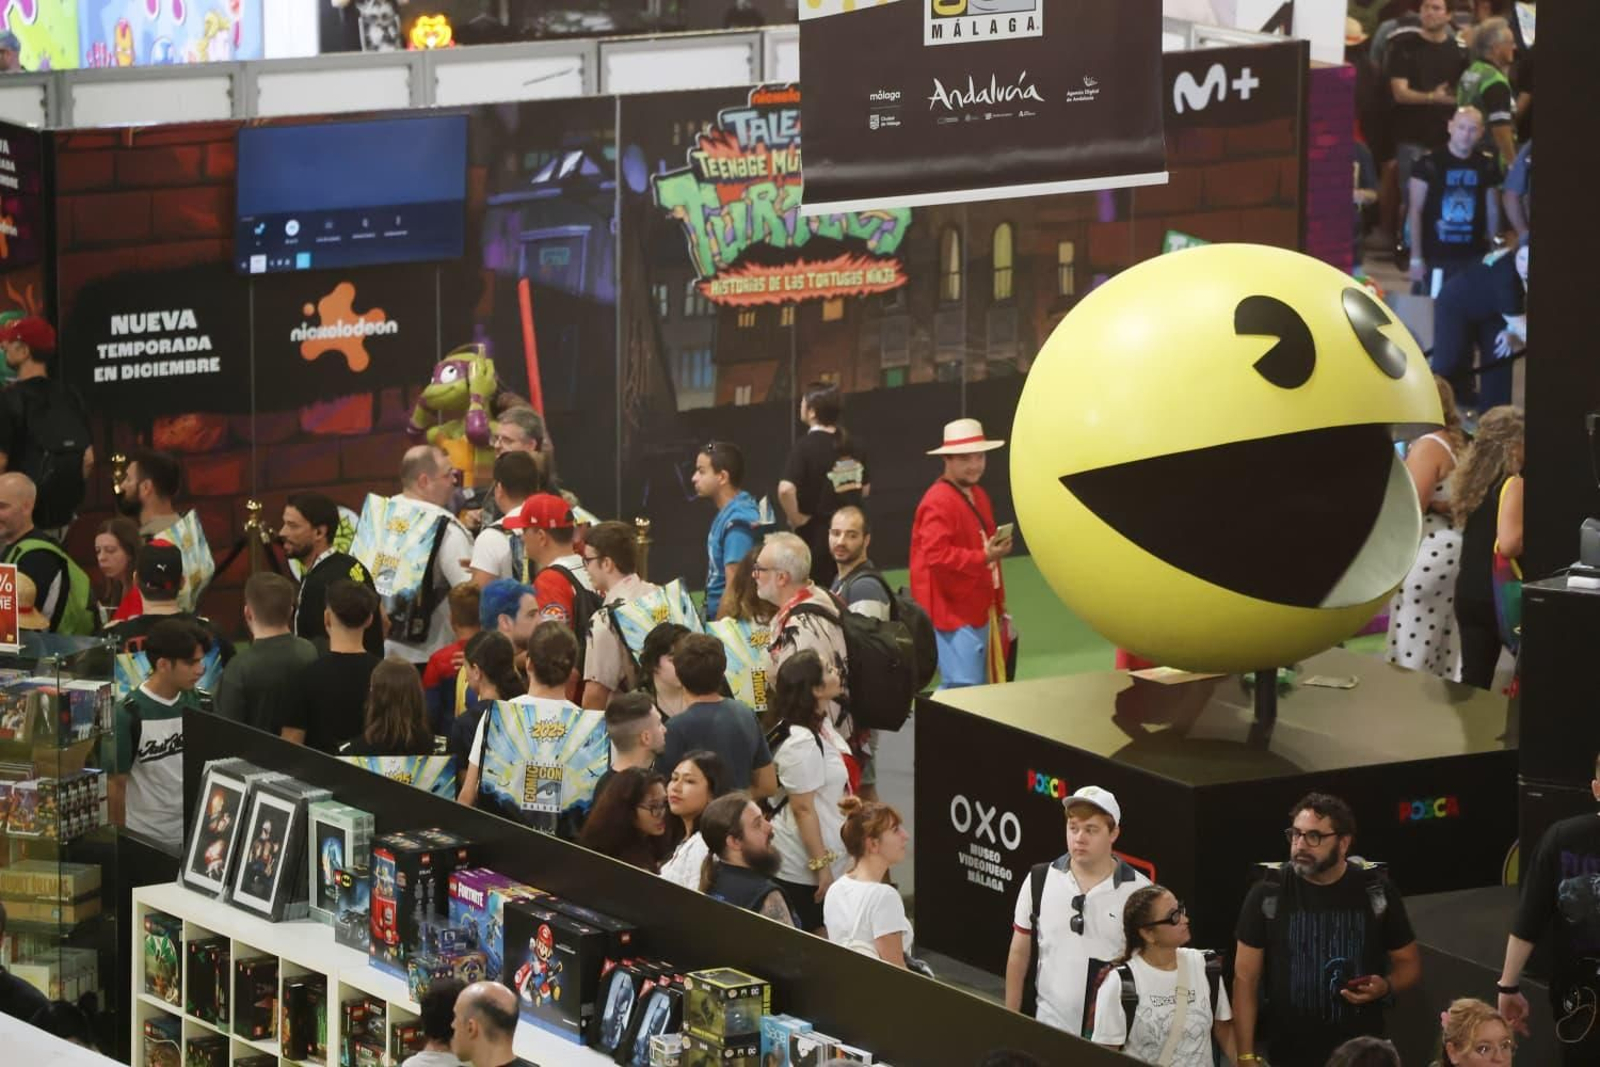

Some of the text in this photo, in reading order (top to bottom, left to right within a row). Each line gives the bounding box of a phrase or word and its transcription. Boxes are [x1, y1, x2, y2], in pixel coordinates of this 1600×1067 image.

[931, 16, 1035, 39] MÁLAGA
[870, 90, 901, 102] málaga
[928, 70, 1045, 111] Andalucía
[722, 109, 801, 147] TALE
[111, 309, 197, 335] NUEVA
[290, 317, 398, 341] nickelodeon
[97, 335, 212, 359] TEMPORADA
[94, 357, 220, 382] EN DICIEMBRE
[530, 723, 567, 738] 2025
[523, 766, 539, 803] COMIC
[539, 766, 563, 781] CON
[1026, 769, 1067, 800] POSCA
[1399, 795, 1460, 823] POSCA
[950, 794, 1022, 851] OXO
[958, 851, 1013, 881] VIDEOJUEGO
[969, 843, 1001, 864] MUSEO
[967, 869, 1004, 892] MÁLAGA
